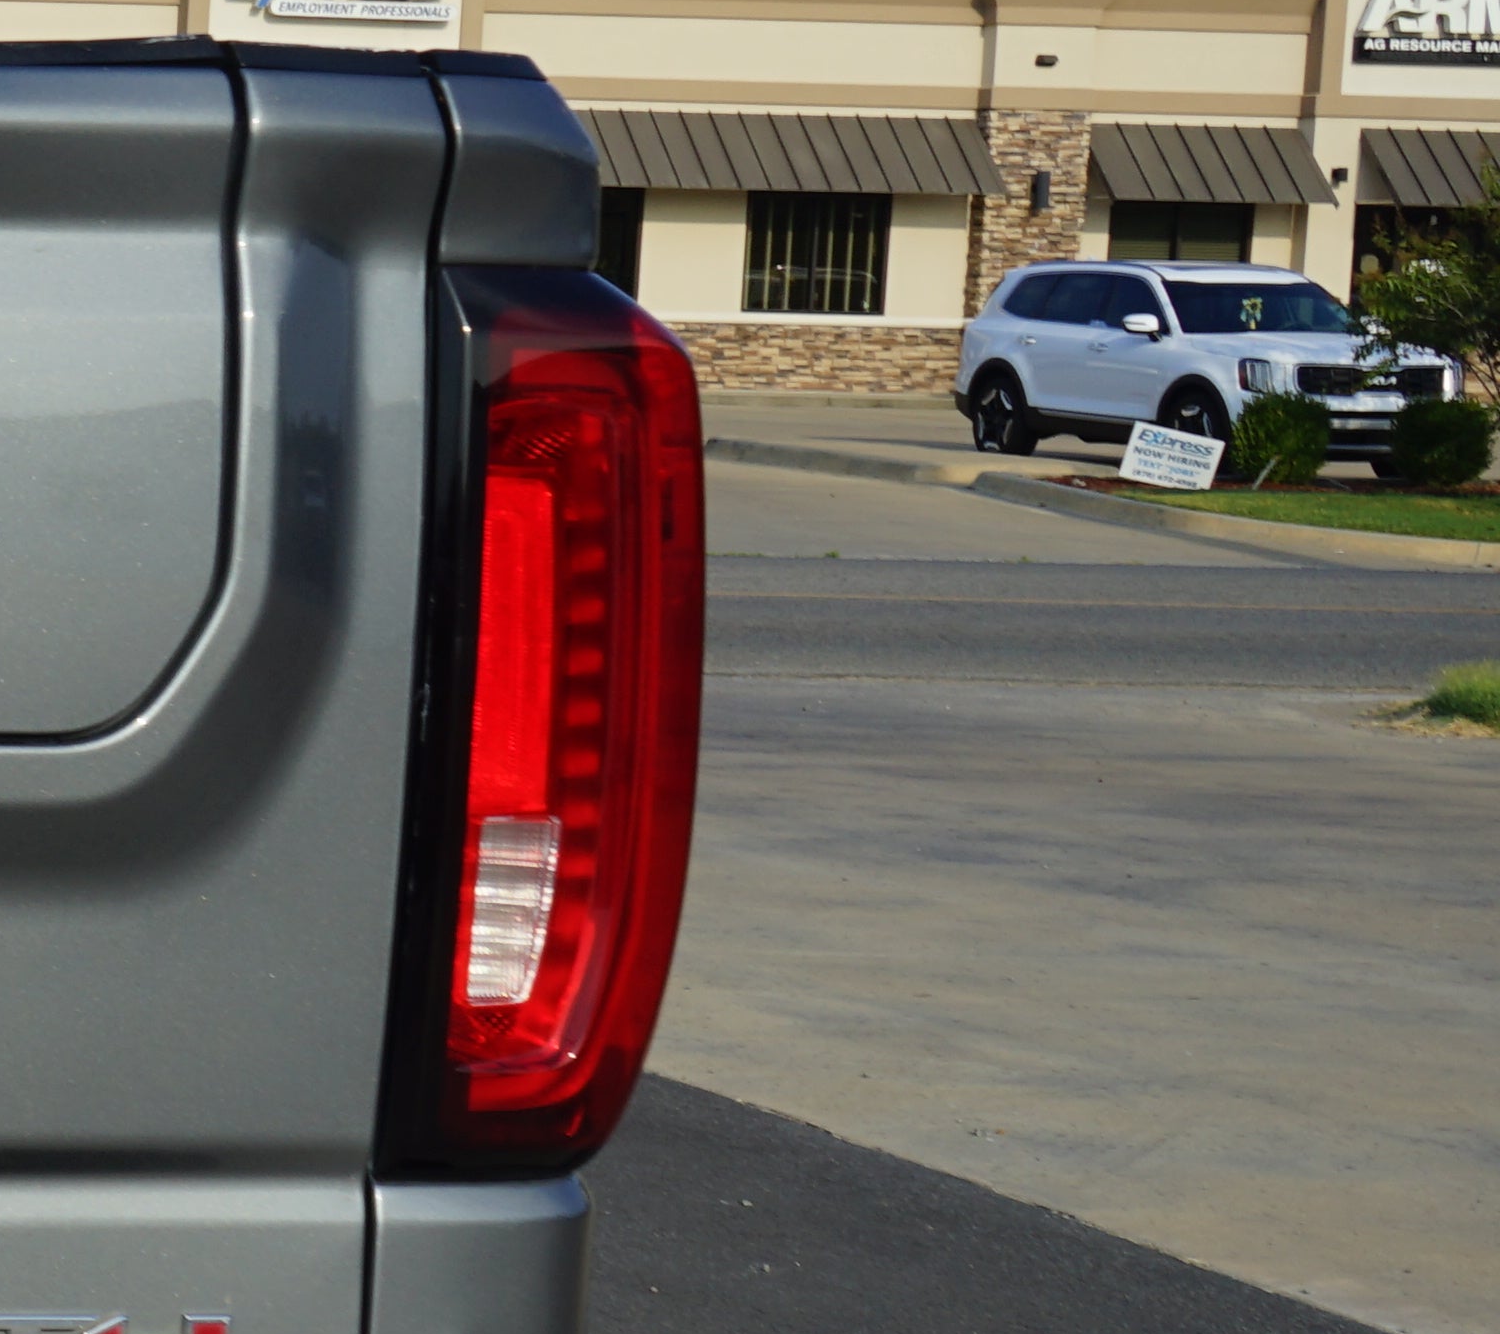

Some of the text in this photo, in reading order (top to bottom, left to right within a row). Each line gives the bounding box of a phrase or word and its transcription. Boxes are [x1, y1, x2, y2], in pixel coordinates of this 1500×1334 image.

[278, 1, 451, 18] EMPLOYMENT PROFESSIONALS
[1363, 38, 1500, 54] AG RESOURCE MA
[1138, 429, 1214, 456] Express
[1133, 446, 1166, 459] NOW
[1167, 454, 1211, 470] HIRING
